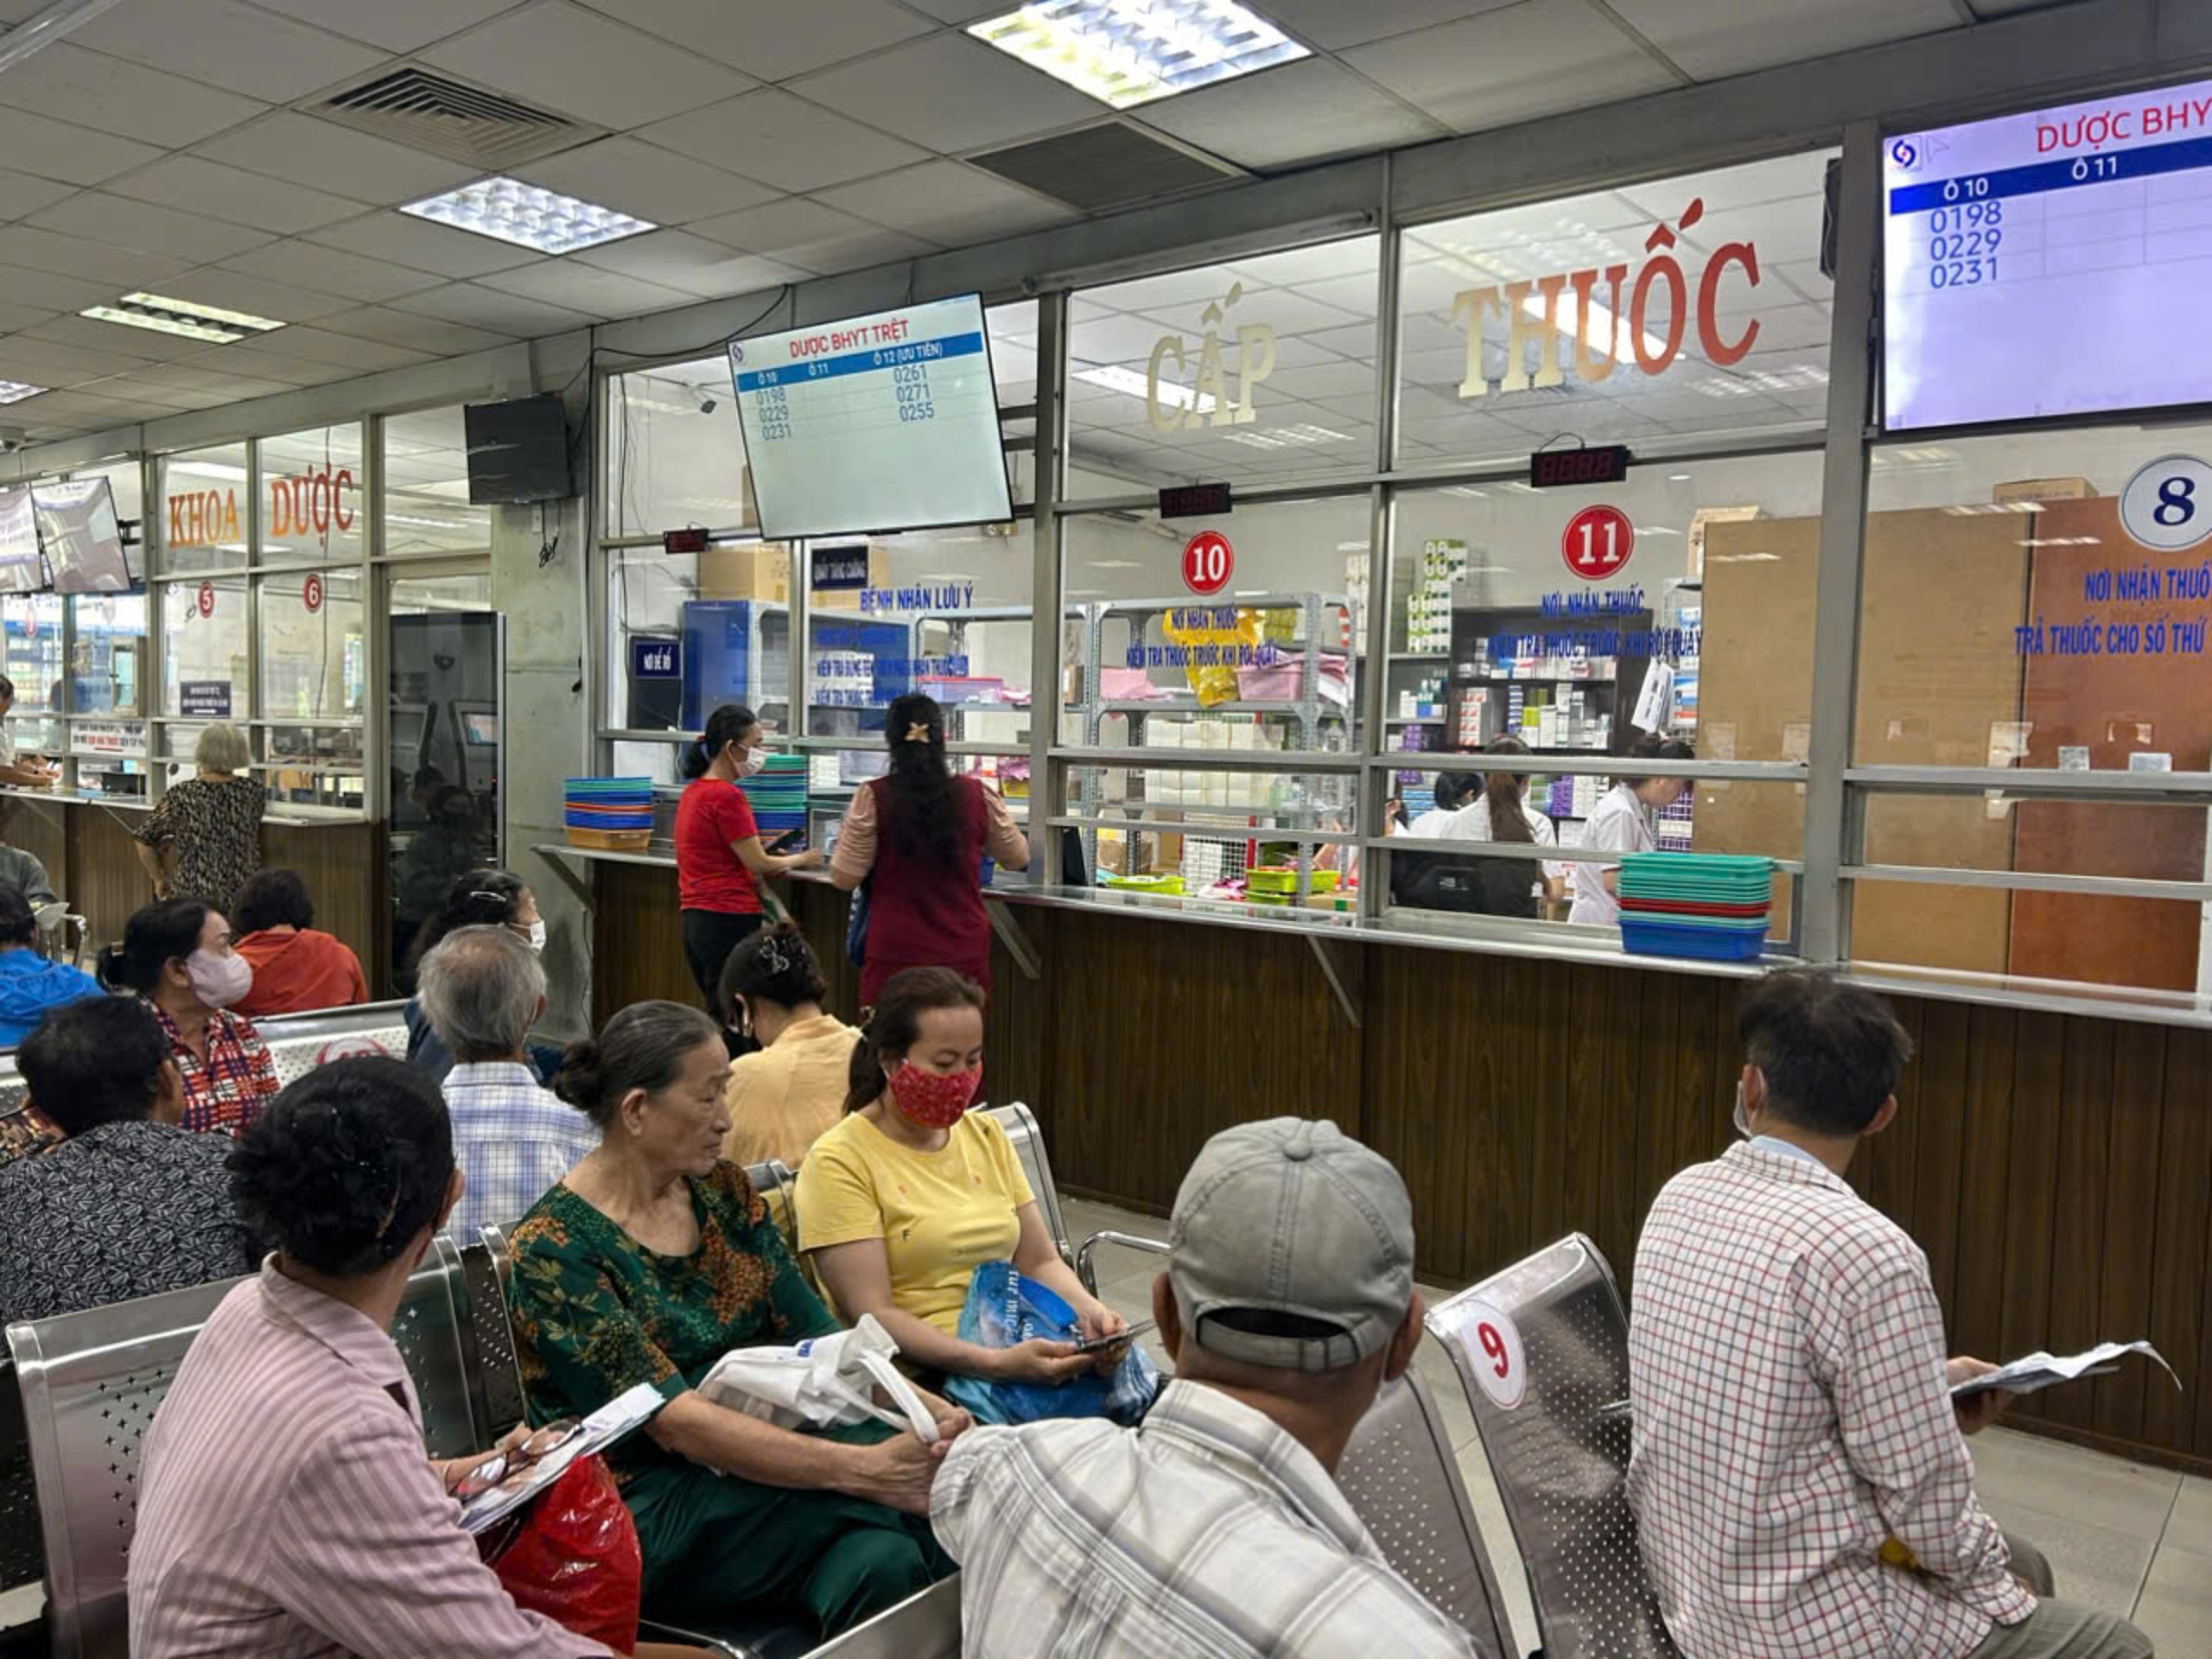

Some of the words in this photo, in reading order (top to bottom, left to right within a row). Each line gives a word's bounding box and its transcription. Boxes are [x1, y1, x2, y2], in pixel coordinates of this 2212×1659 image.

[2037, 111, 2131, 153] DƯỢC
[2072, 156, 2088, 180] Ô
[2094, 156, 2117, 177] 11
[1943, 178, 1959, 201] Ô
[1965, 177, 1989, 199] 10
[1929, 200, 2003, 234] 0198
[1929, 228, 2003, 262] 0229
[1929, 257, 1998, 289] 0231
[1146, 282, 1279, 433] CẤP
[1452, 197, 1761, 398] THUỐC
[790, 335, 830, 359] DƯỢC
[832, 327, 868, 351] BHYT
[873, 317, 909, 344] TRỆT
[817, 362, 829, 374] 11
[883, 349, 896, 364] 12
[893, 364, 928, 385] 0261
[756, 386, 787, 405] 0198
[896, 384, 931, 404] 0271
[759, 404, 789, 423] 0229
[899, 402, 935, 423] 0255
[762, 423, 792, 442] 0231
[169, 487, 240, 550] KHOA
[270, 461, 354, 547] DƯỢC
[2152, 476, 2196, 526] 8
[1578, 519, 1620, 565] 11
[1192, 543, 1225, 582] 10
[202, 588, 211, 610] 5
[308, 584, 318, 605] 6
[964, 580, 974, 609] Ý
[1605, 583, 1645, 616] THUỐC
[2084, 567, 2113, 602] NƠI
[2116, 561, 2161, 607] NHẬN
[2014, 615, 2044, 655] TRẢ
[2050, 614, 2102, 655] THUỐC
[2107, 623, 2139, 654] CHO
[2144, 611, 2171, 654] SỐ
[1478, 1321, 1509, 1380] 9
